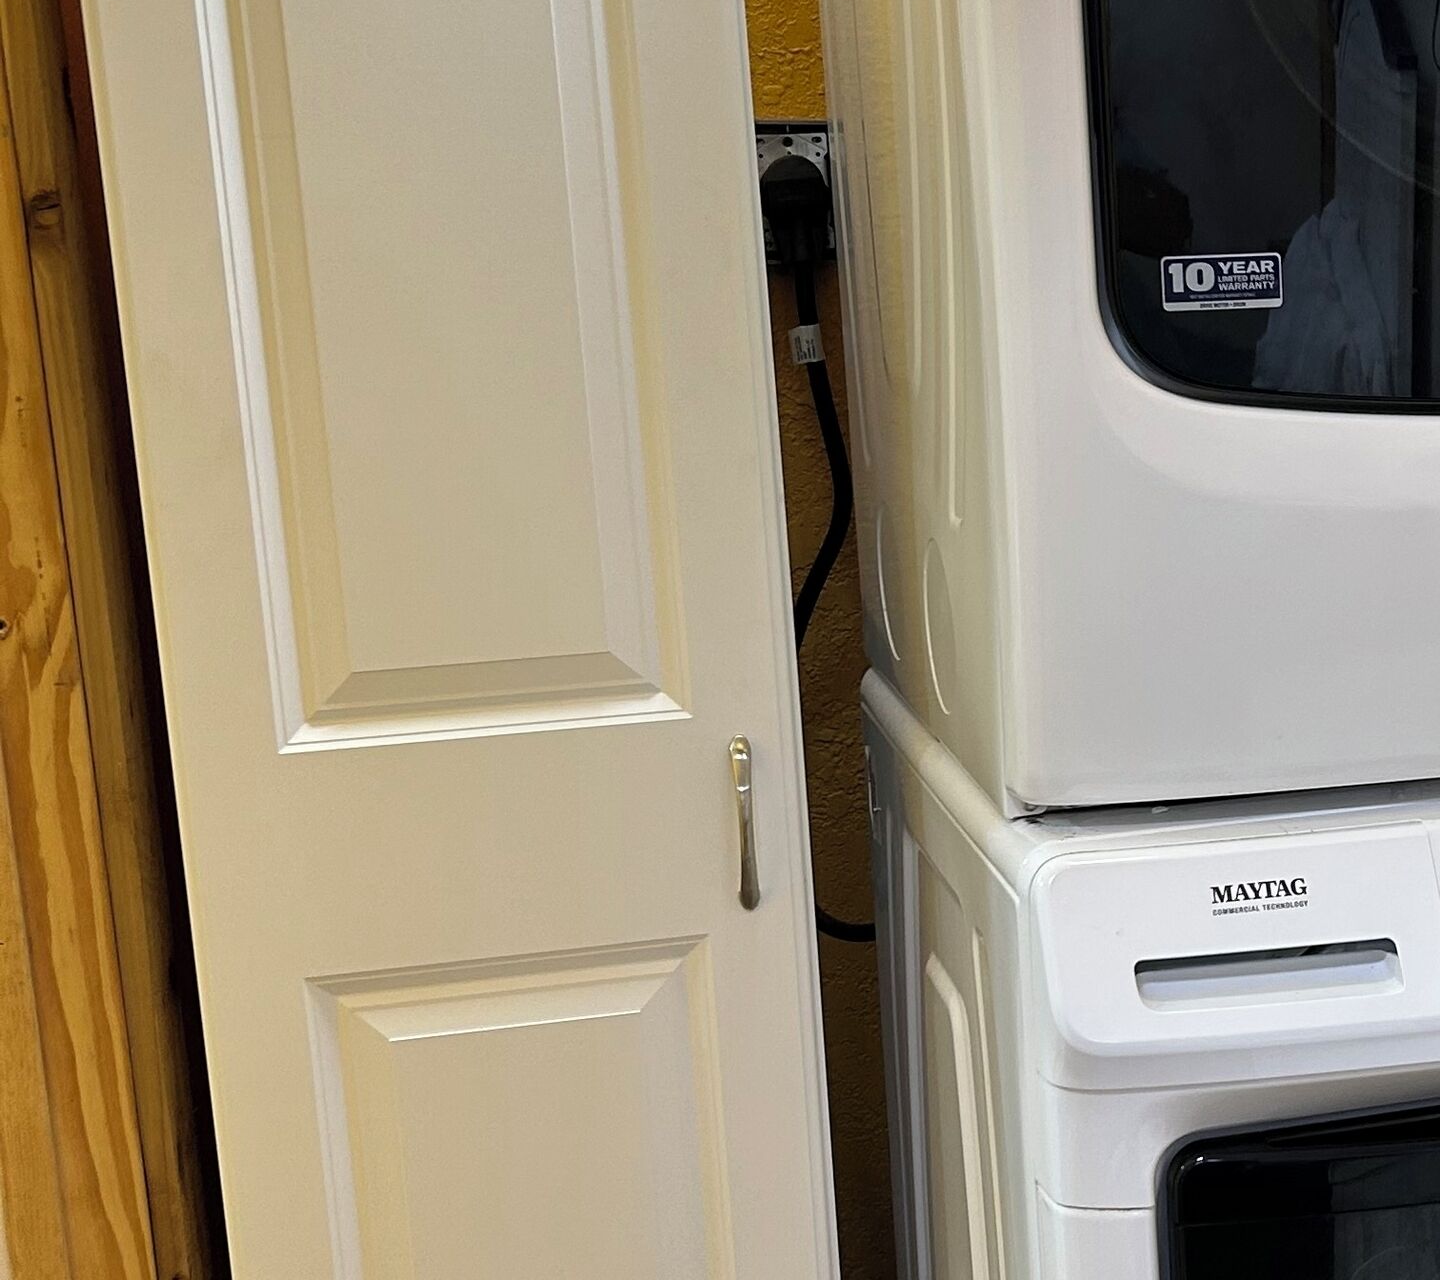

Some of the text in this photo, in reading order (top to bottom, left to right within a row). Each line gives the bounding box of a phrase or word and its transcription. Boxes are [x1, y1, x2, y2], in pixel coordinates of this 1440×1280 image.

[1168, 260, 1275, 293] 10 YEAR
[1218, 281, 1275, 291] WARRANTY
[1210, 878, 1307, 904] MAYTAG
[1212, 900, 1308, 916] COMMERCIAL TECHNOLOGY
